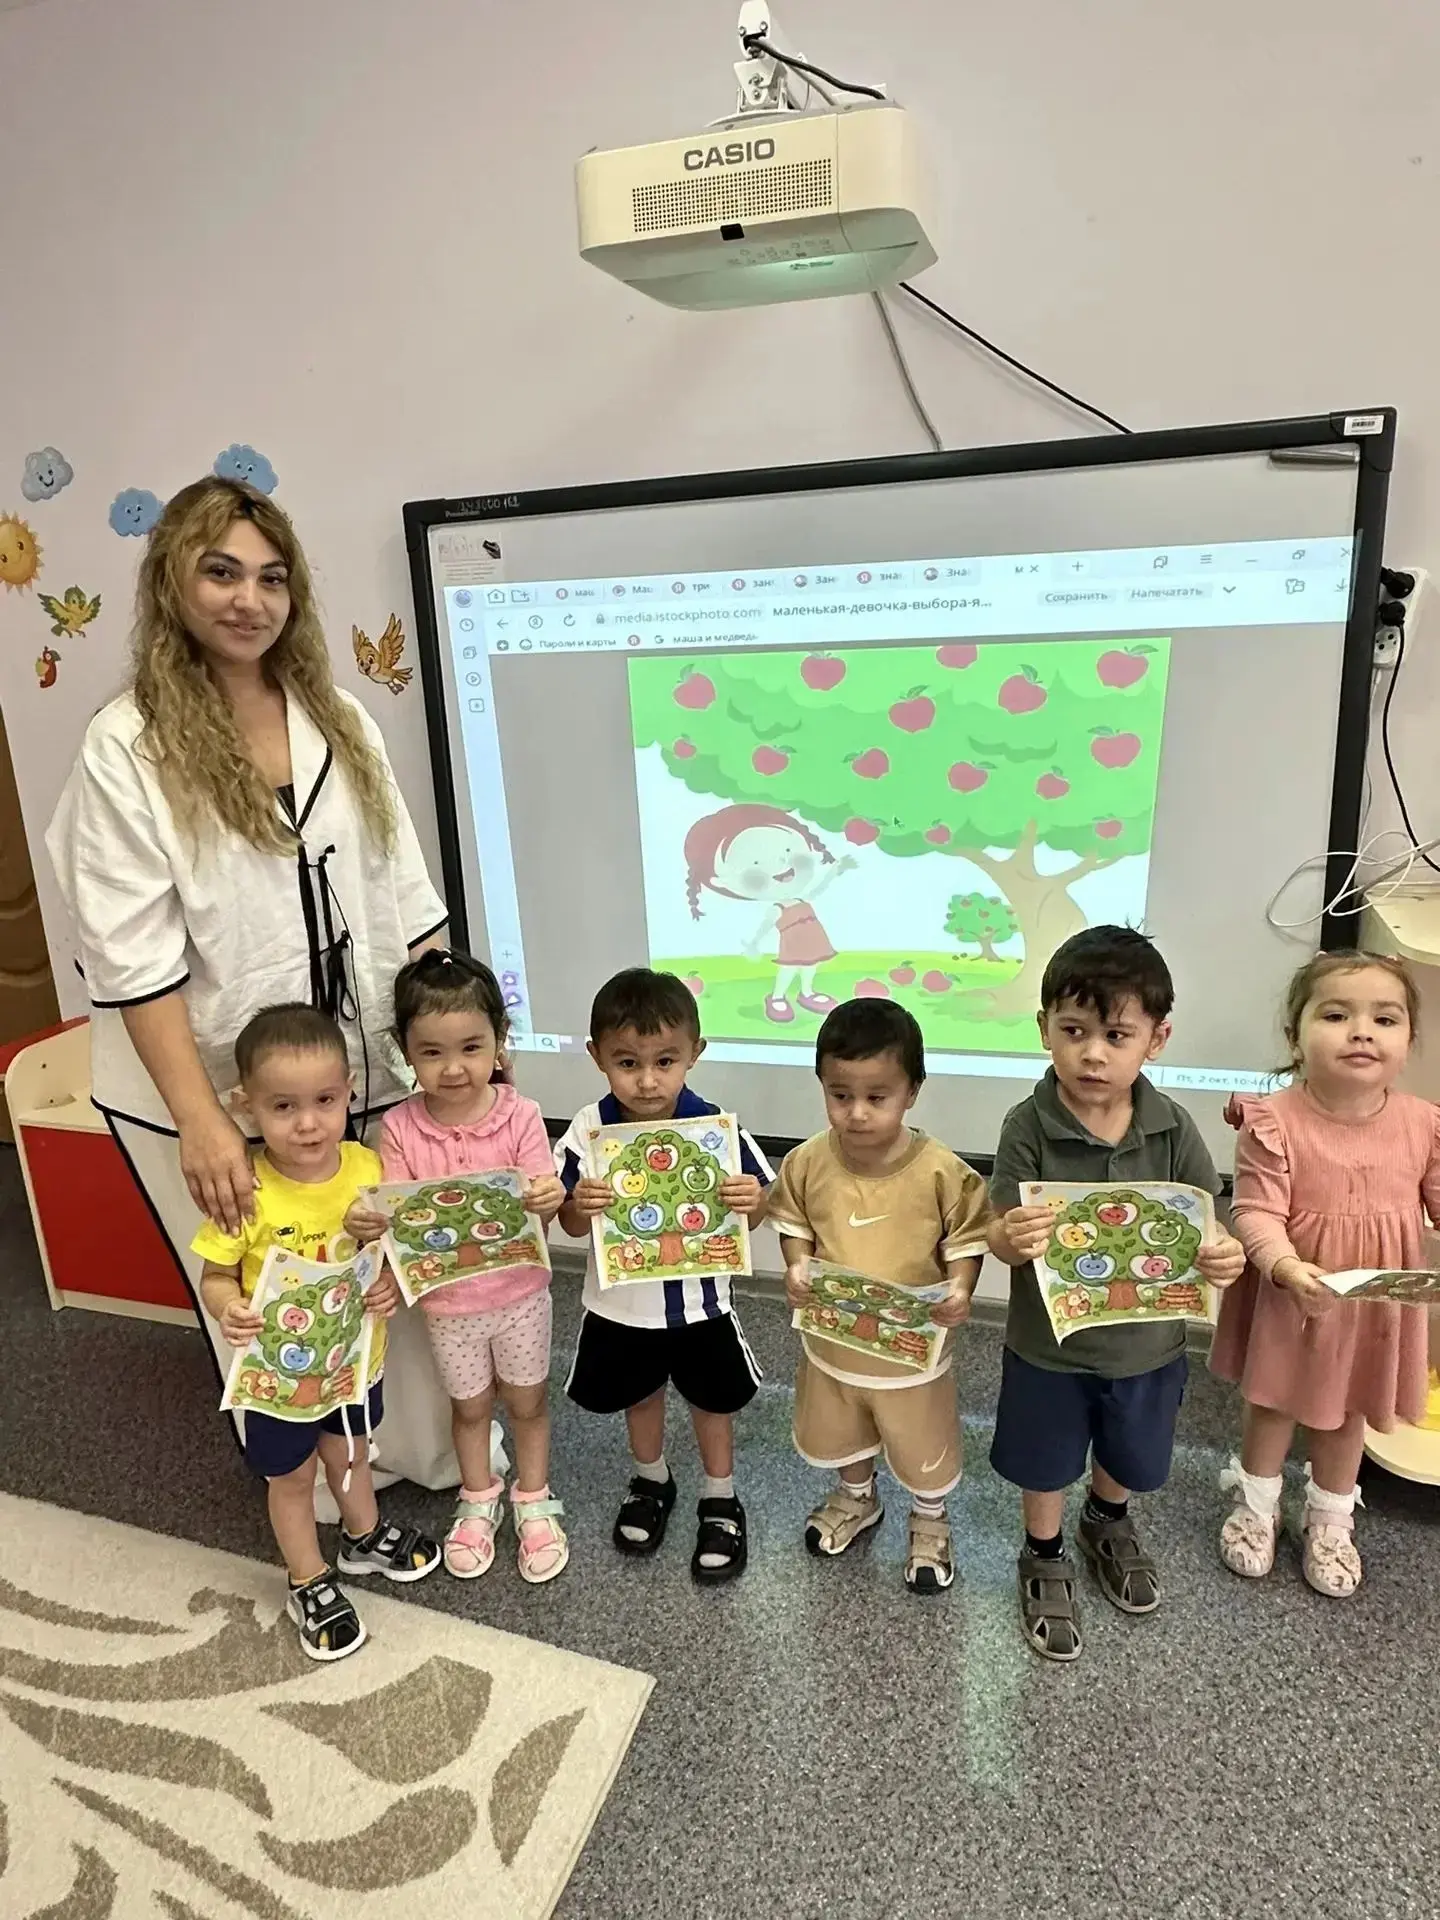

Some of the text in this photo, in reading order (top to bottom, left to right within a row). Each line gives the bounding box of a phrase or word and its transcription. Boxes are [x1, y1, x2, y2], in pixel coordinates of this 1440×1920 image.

[684, 138, 775, 171] CASIO
[879, 572, 902, 582] зна
[946, 568, 970, 578] Зна
[752, 579, 775, 589] зан
[815, 575, 837, 585] Зан
[1130, 586, 1204, 599] Напечатать
[1044, 592, 1109, 605] Сохранить
[614, 608, 762, 625] media.istockphoto.com
[539, 639, 577, 649] Пароли
[586, 637, 617, 648] карты
[673, 634, 703, 644] маша
